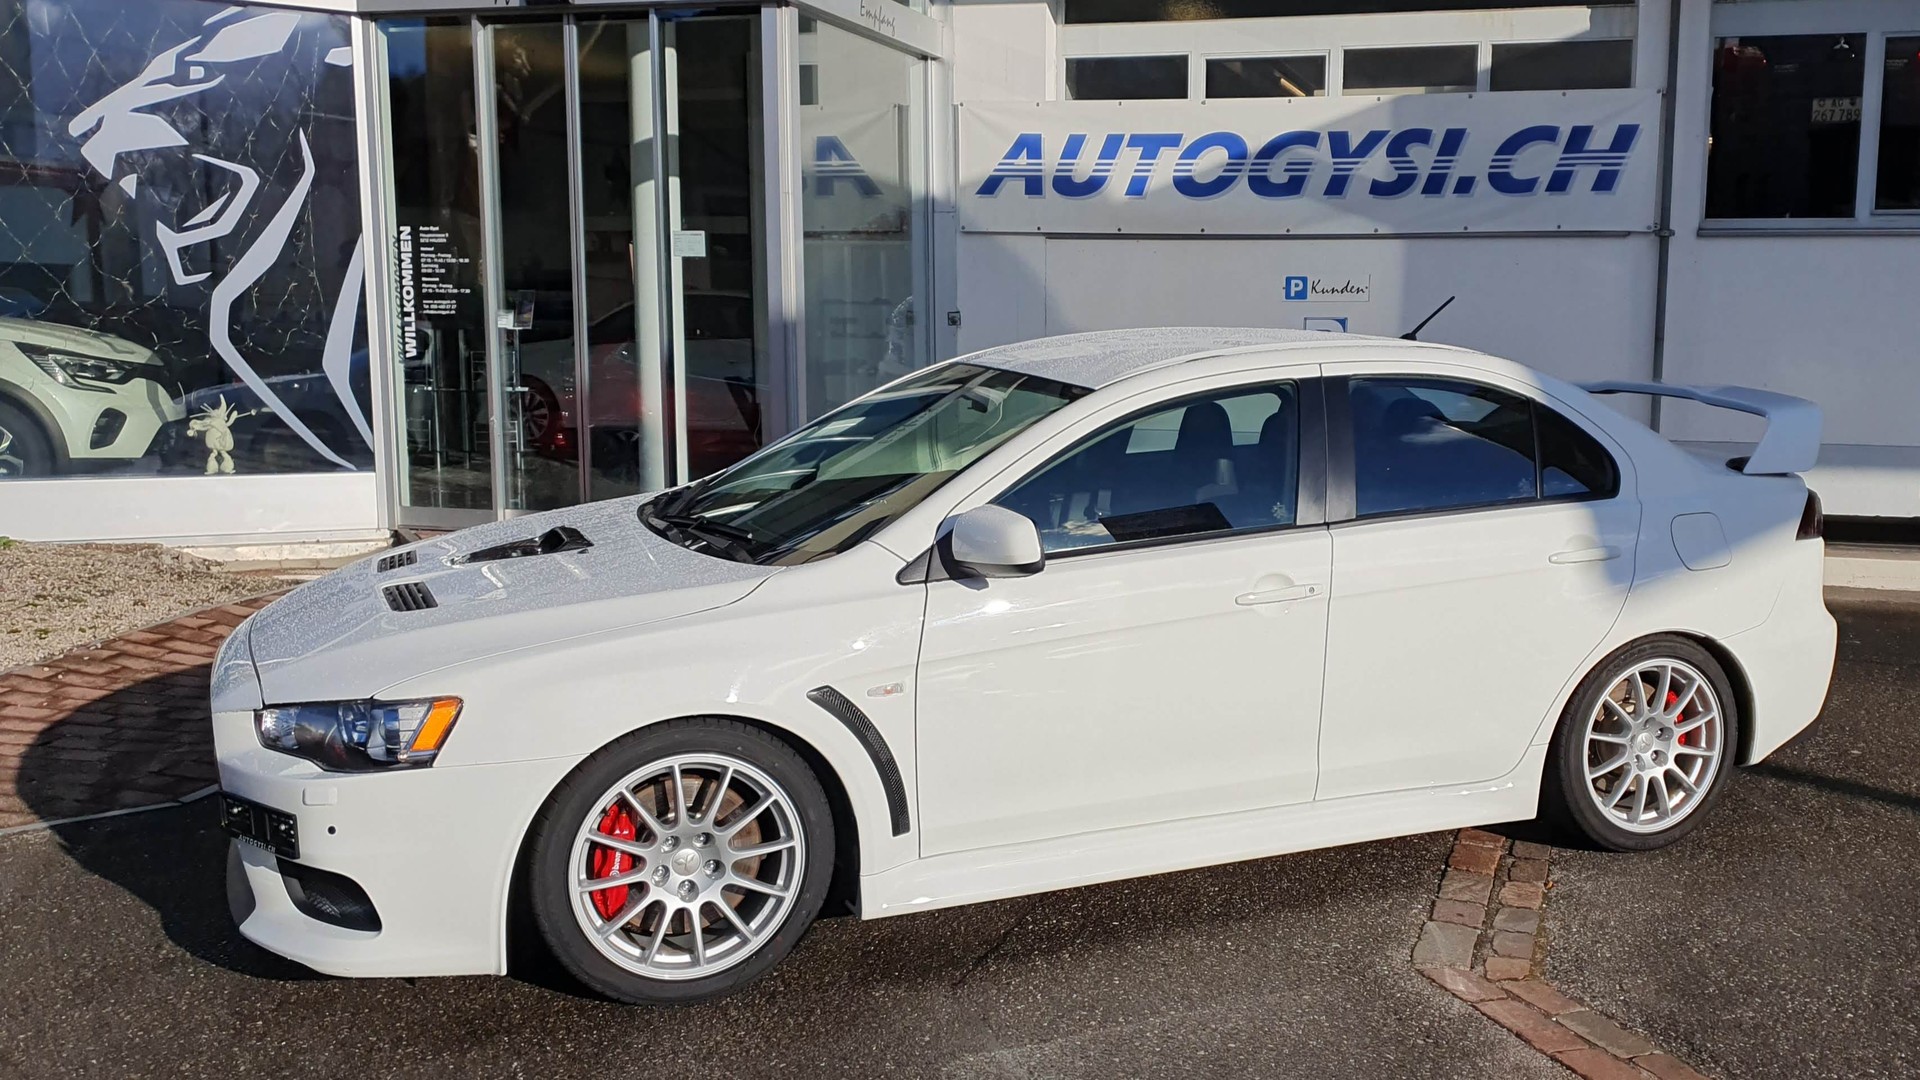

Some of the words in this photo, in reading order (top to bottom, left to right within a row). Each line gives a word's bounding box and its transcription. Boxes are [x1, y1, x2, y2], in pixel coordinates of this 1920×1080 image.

[860, 0, 896, 37] Empfang
[974, 123, 1642, 199] AUTOGYSI.CH
[400, 226, 417, 358] WILLKOMMEN
[1290, 279, 1304, 297] P
[1311, 278, 1366, 295] Kunden
